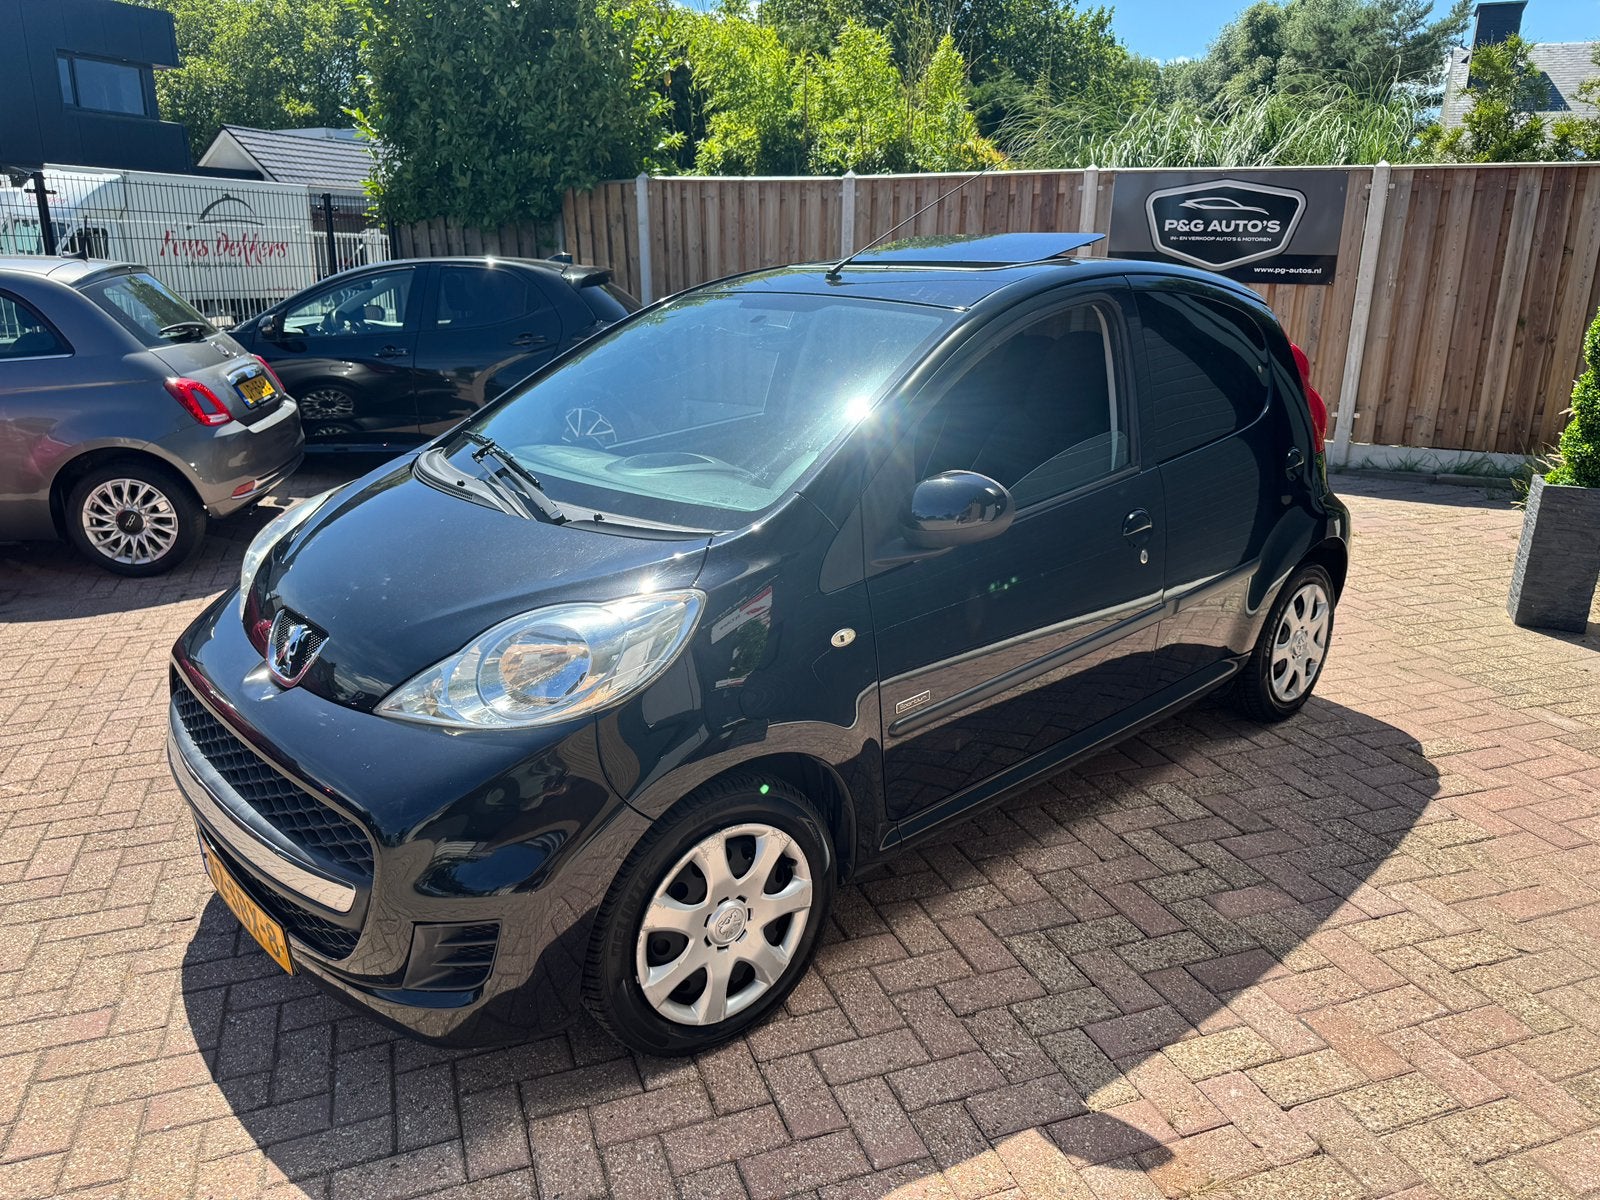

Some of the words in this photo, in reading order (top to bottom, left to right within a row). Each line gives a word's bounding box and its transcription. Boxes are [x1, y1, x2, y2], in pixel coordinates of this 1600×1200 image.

[1164, 219, 1205, 232] P&G
[1207, 219, 1281, 233] AUTO'S
[1253, 267, 1322, 275] www.pg-autos.nl
